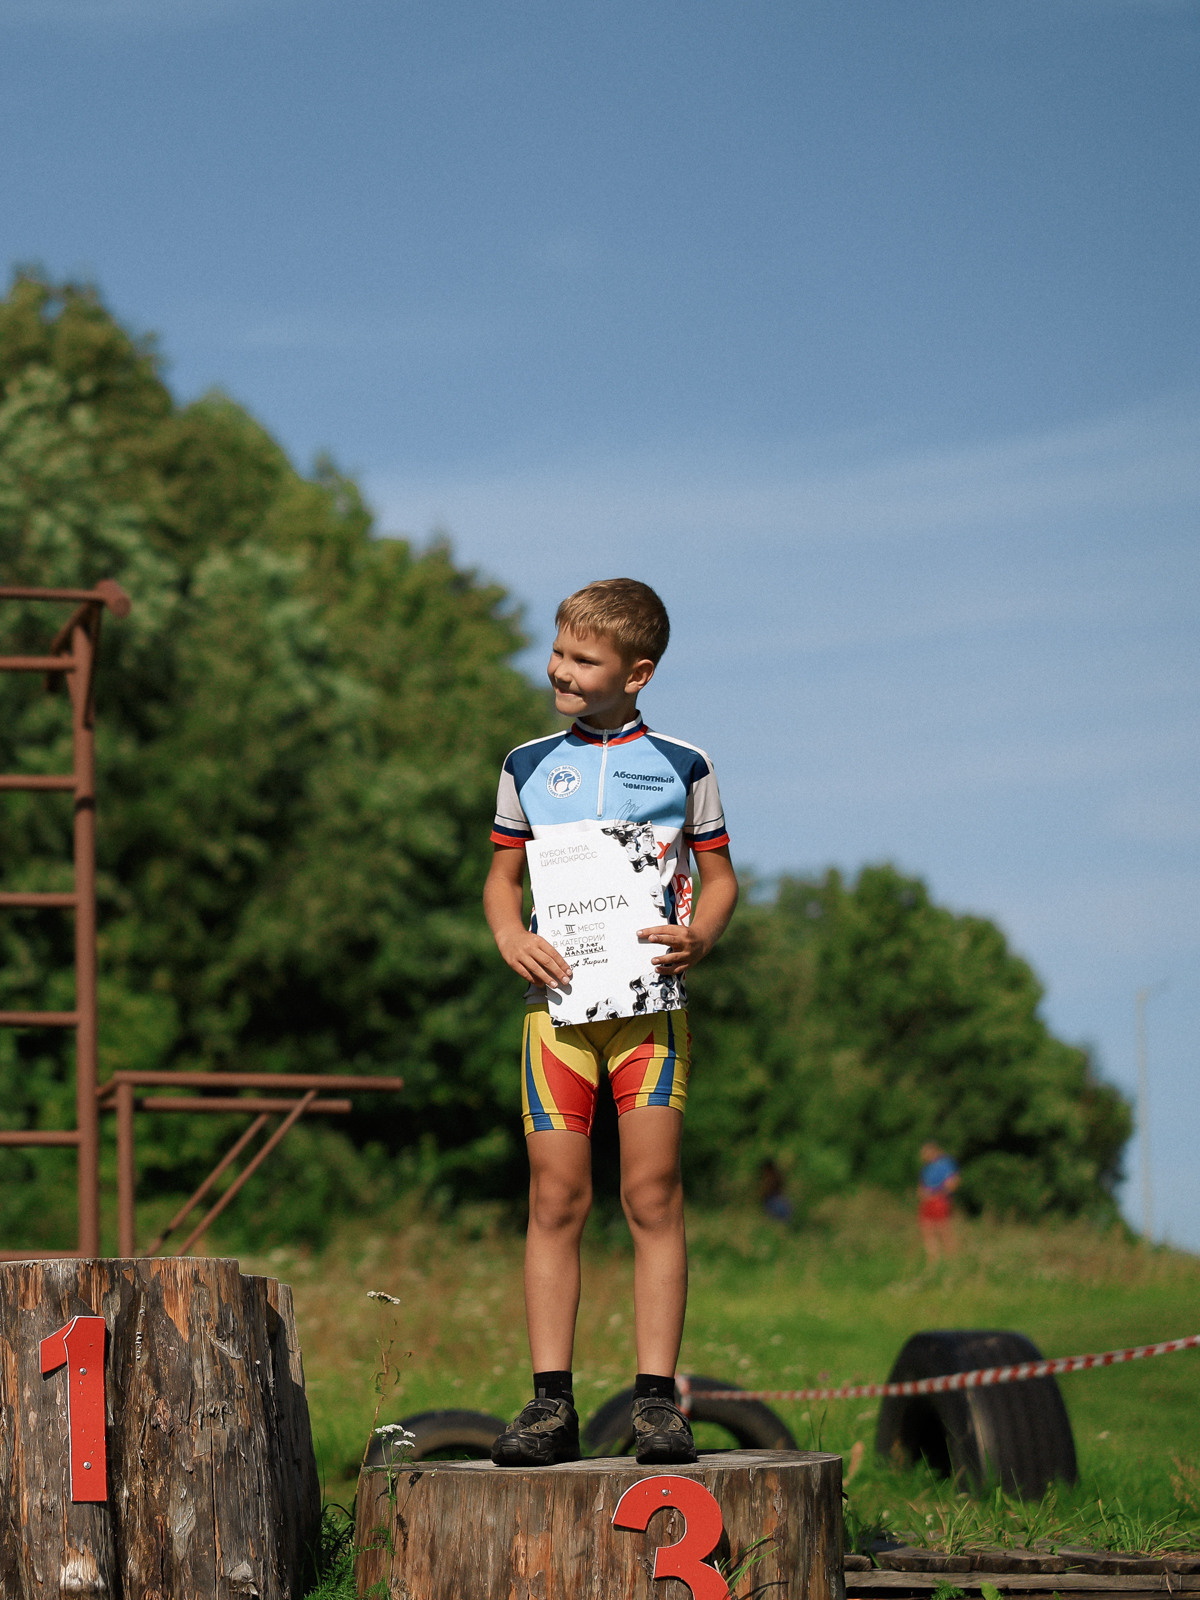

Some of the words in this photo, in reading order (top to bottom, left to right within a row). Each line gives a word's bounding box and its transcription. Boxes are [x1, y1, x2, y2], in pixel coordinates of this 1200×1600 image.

[612, 770, 675, 784] Абсолютный
[622, 782, 664, 792] чемпион
[539, 849, 566, 858] КУБОК
[567, 845, 589, 853] ТИПА
[540, 852, 598, 867] ЦИКЛОКРОСС
[547, 894, 629, 919] ГРАМОТА
[550, 929, 562, 937] ЗА
[578, 922, 605, 932] МЕСТО
[559, 934, 606, 947] КАТЕГОРИИ
[39, 1315, 107, 1501] 1
[611, 1474, 731, 1600] 3
